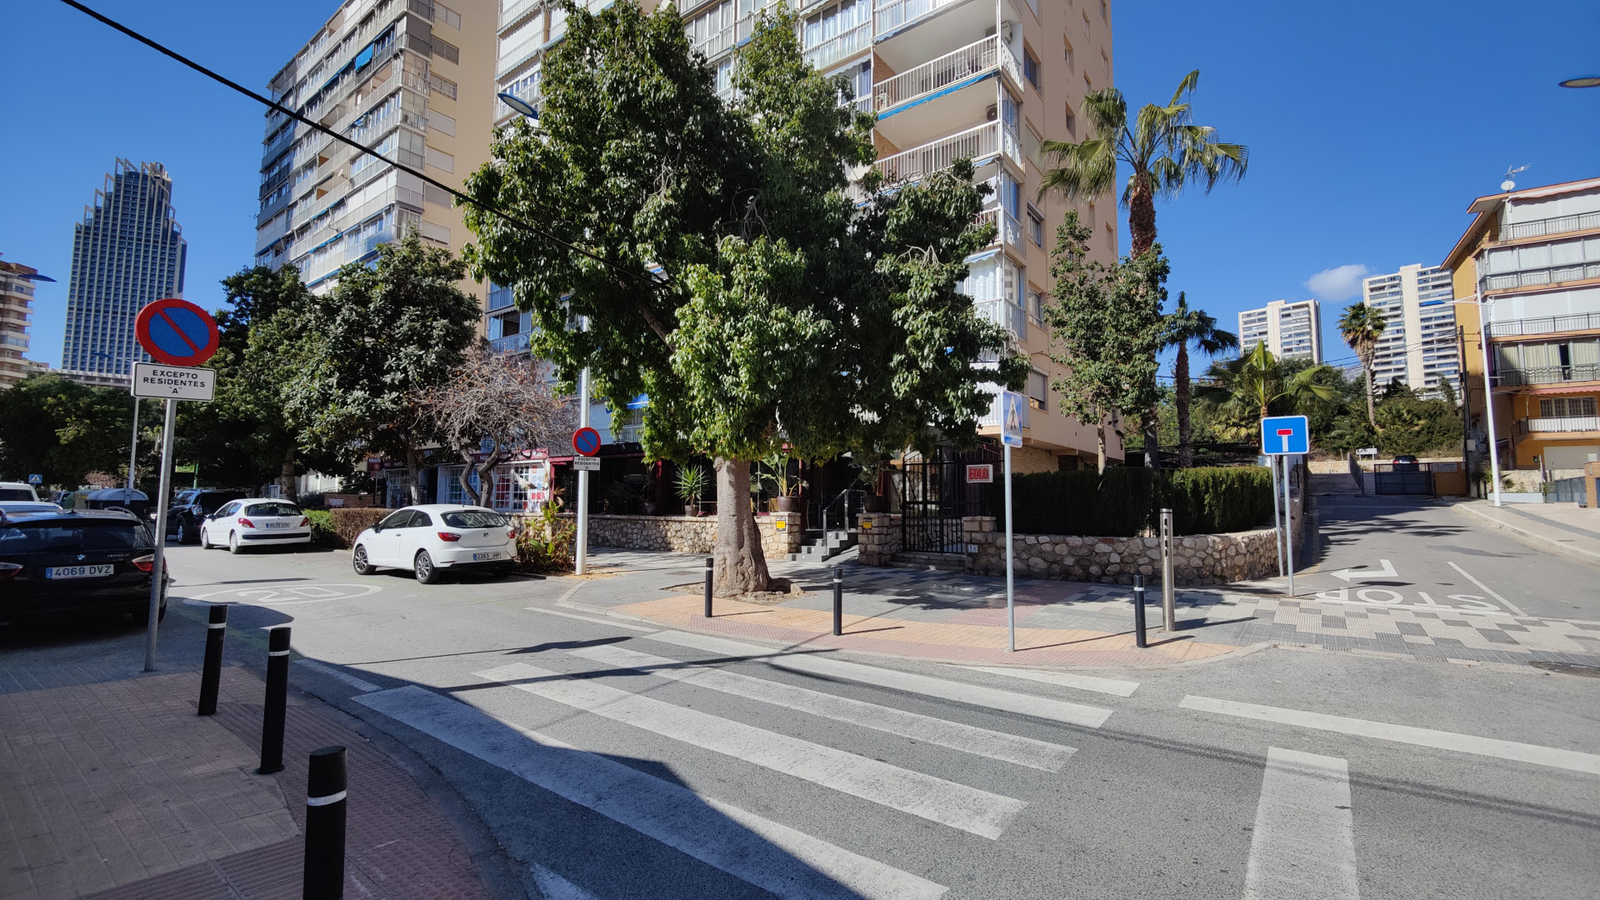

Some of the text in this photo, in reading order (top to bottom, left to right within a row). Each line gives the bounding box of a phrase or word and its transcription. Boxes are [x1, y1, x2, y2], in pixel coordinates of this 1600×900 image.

[152, 369, 198, 380] EXCEPTO
[143, 377, 206, 388] RESIDENTES
[969, 467, 989, 480] EOLO
[54, 565, 111, 577] 4069 DVZ
